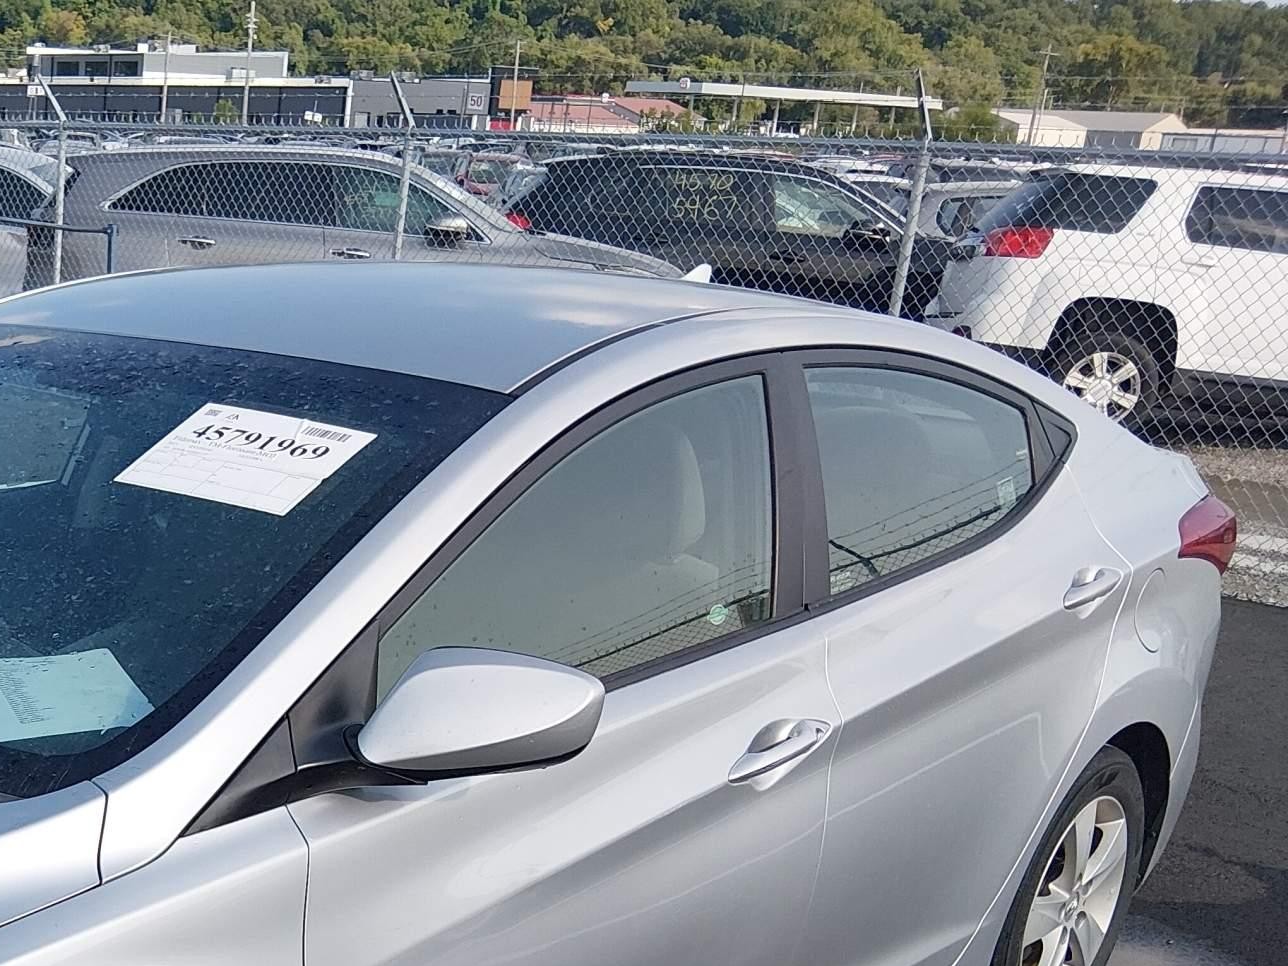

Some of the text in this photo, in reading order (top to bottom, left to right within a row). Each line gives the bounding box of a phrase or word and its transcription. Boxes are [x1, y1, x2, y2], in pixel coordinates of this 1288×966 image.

[470, 95, 483, 107] 50
[674, 171, 733, 190] 4570
[192, 424, 331, 460] 45791969
